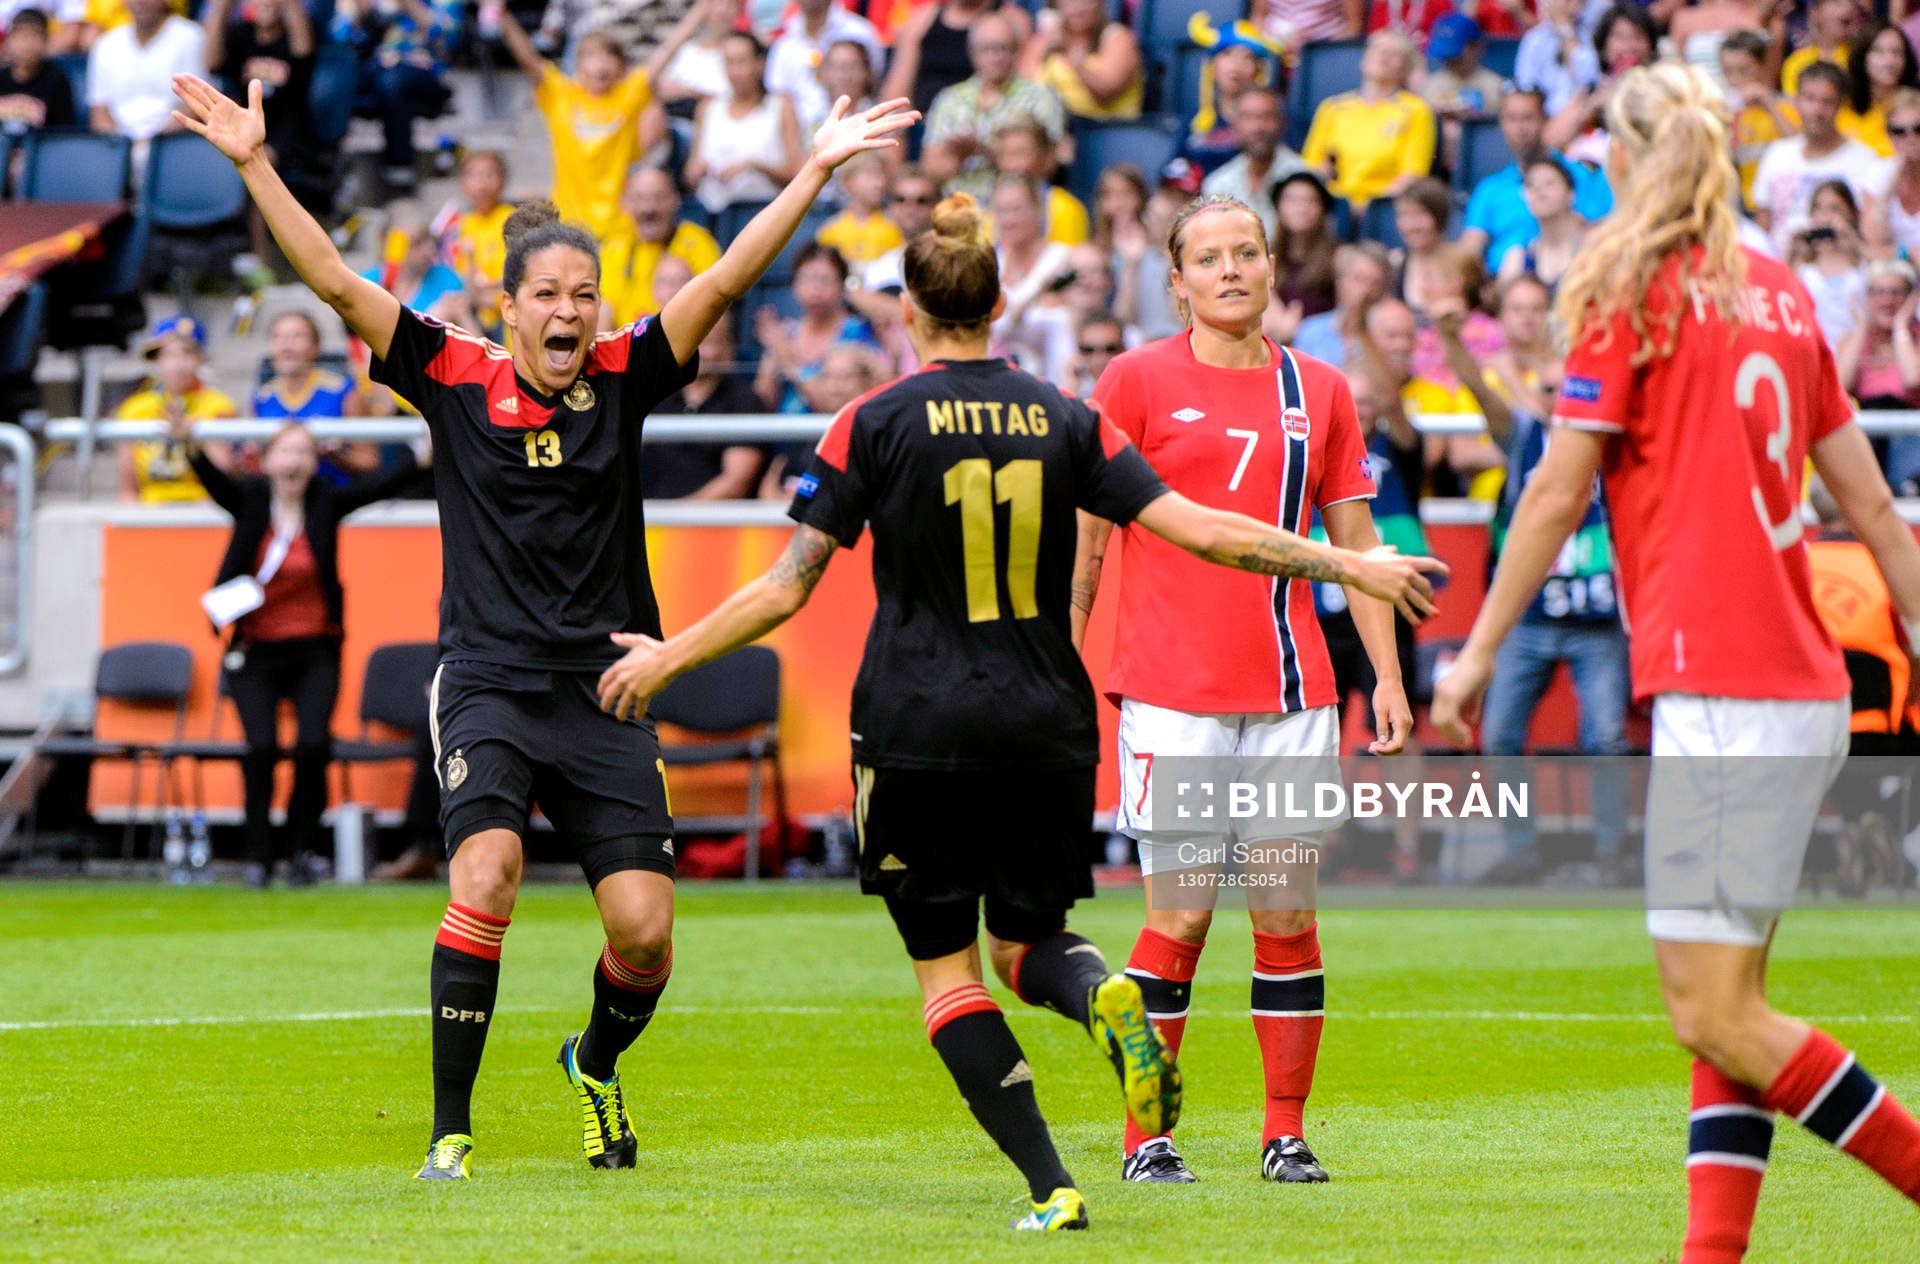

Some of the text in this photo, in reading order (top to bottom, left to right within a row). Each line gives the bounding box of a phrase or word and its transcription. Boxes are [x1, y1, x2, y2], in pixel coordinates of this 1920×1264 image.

[523, 430, 562, 467] 13
[926, 400, 1049, 437] MITTAG
[1226, 428, 1259, 491] 7
[1735, 352, 1804, 551] 3
[943, 458, 1042, 622] 11
[1133, 753, 1153, 815] 7
[441, 1005, 486, 1023] DFB
